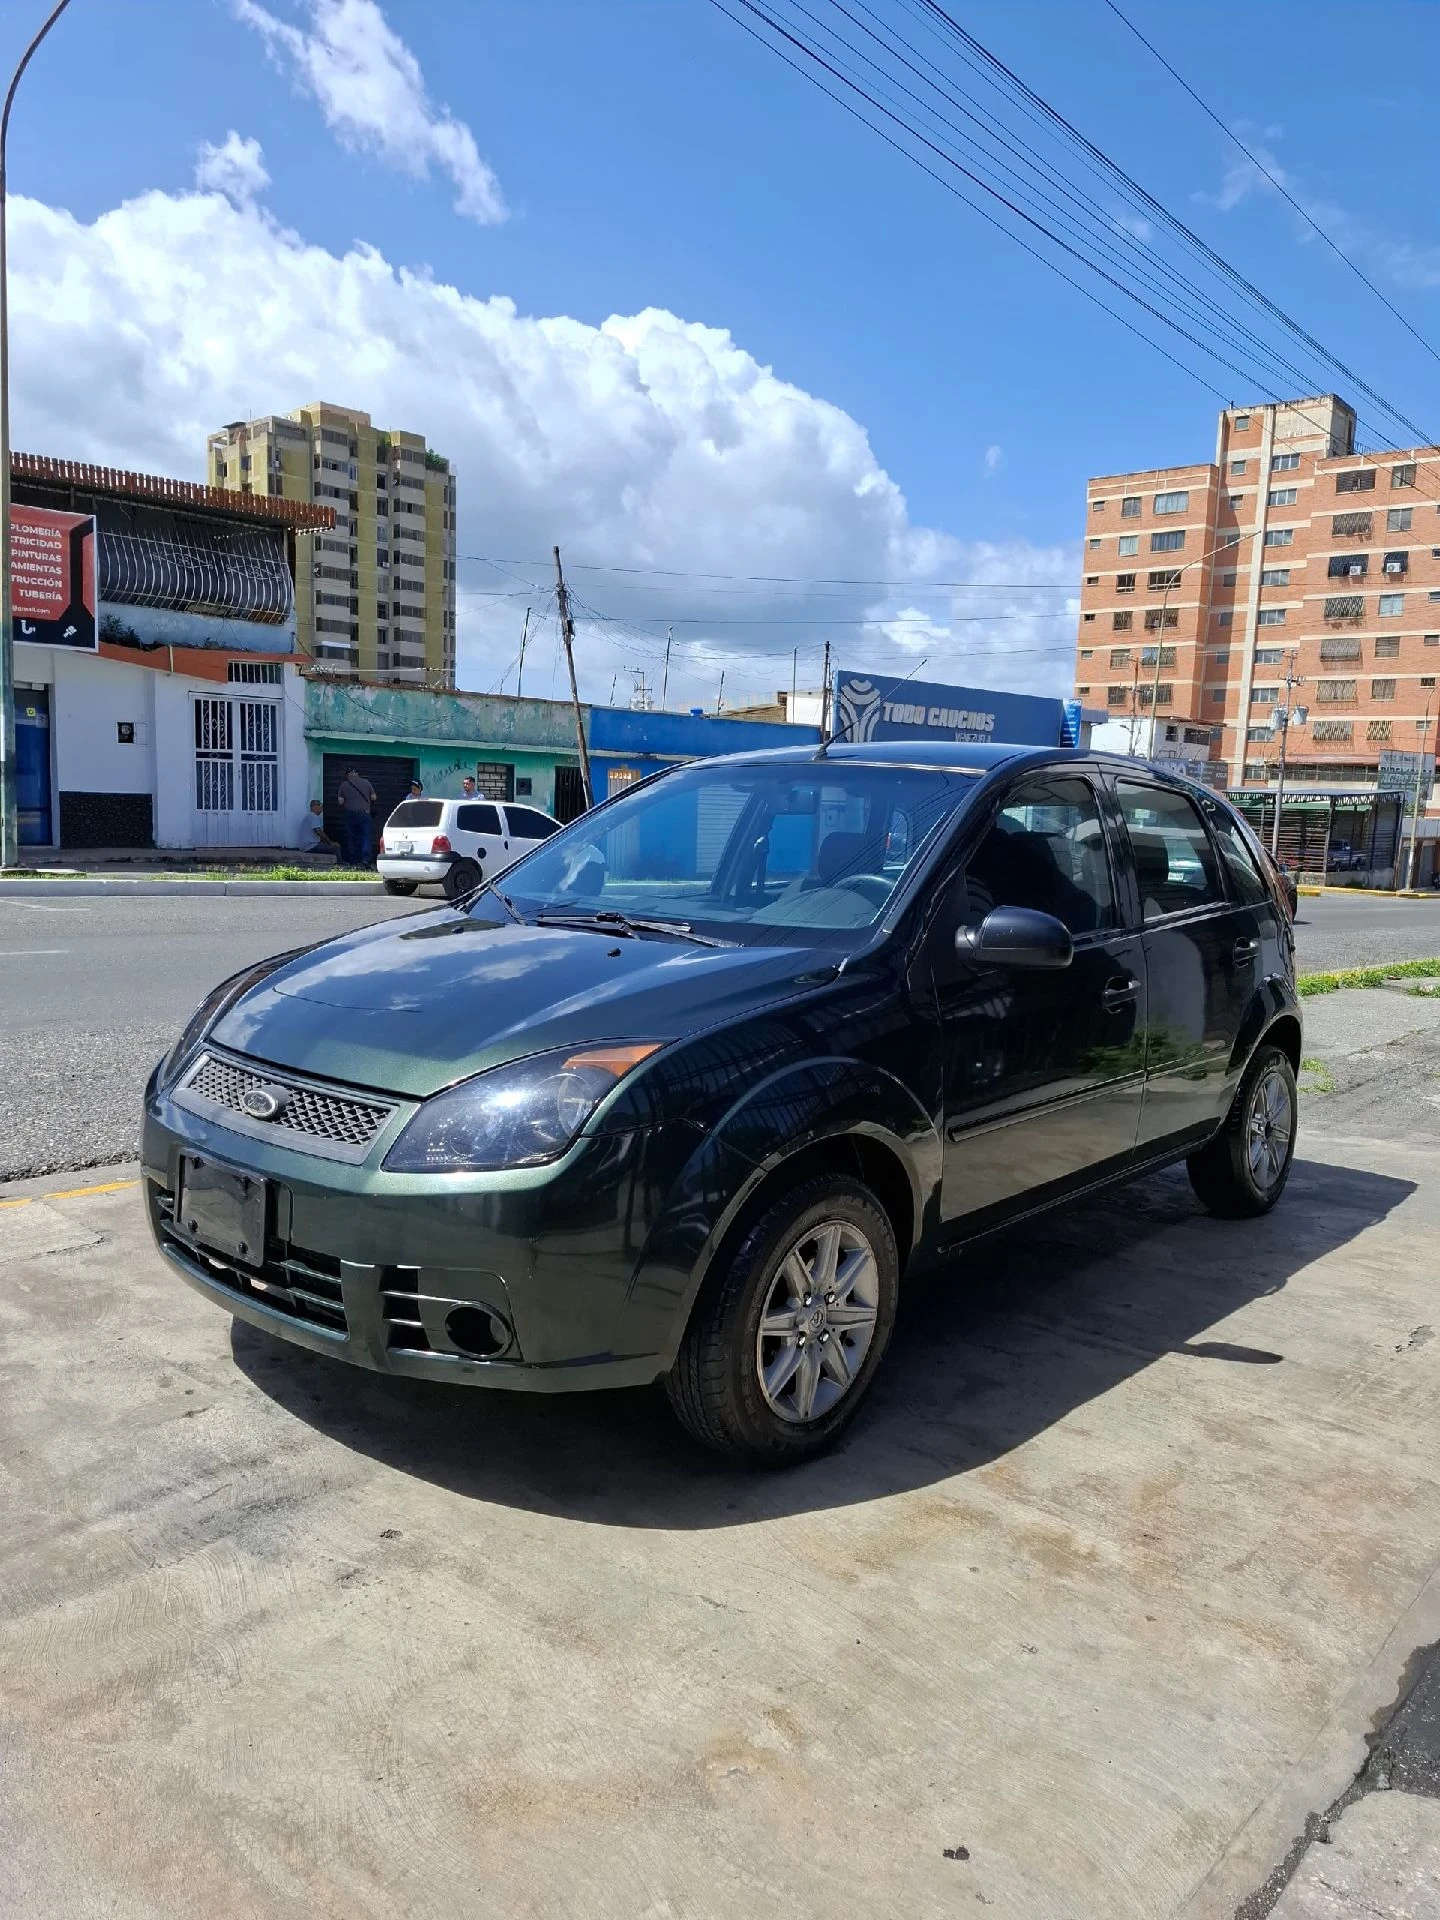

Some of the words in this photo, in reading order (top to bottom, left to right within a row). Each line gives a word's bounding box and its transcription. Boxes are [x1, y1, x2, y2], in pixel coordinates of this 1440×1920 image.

[10, 535, 62, 549] TRICIDAD
[11, 549, 62, 562] PINTURAS
[19, 589, 62, 601] TUBERÍA
[882, 701, 926, 725] TODO
[927, 707, 995, 732] CAUCHOS
